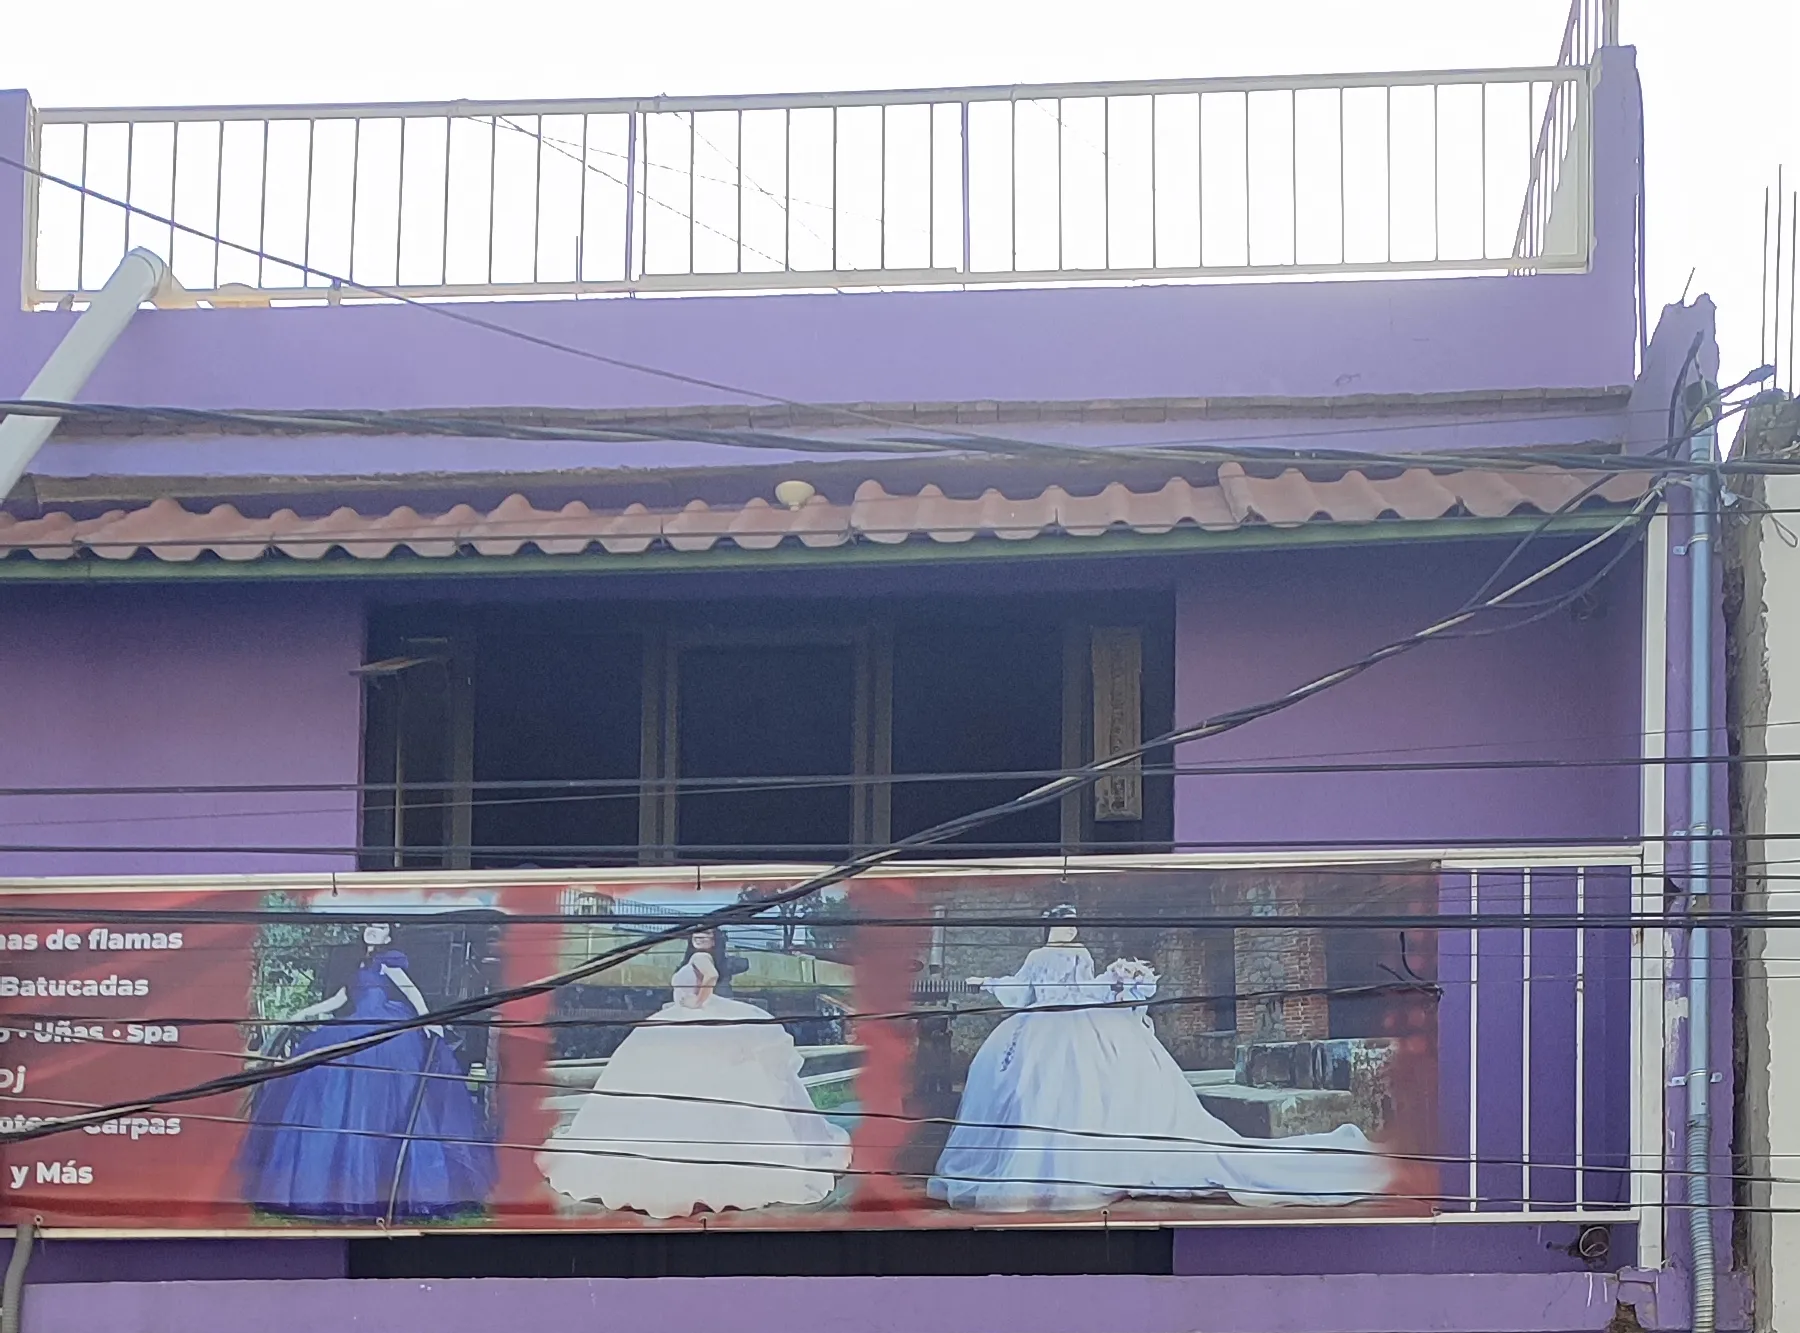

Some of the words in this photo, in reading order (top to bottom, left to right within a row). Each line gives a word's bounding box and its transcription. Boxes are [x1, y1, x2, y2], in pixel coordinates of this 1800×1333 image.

[46, 928, 80, 950] de
[88, 928, 183, 950] flamas
[0, 975, 149, 997] Batucadas
[34, 1020, 104, 1043] Uñas
[126, 1023, 179, 1045] Spa
[10, 1165, 29, 1189] y
[36, 1160, 94, 1185] Más
